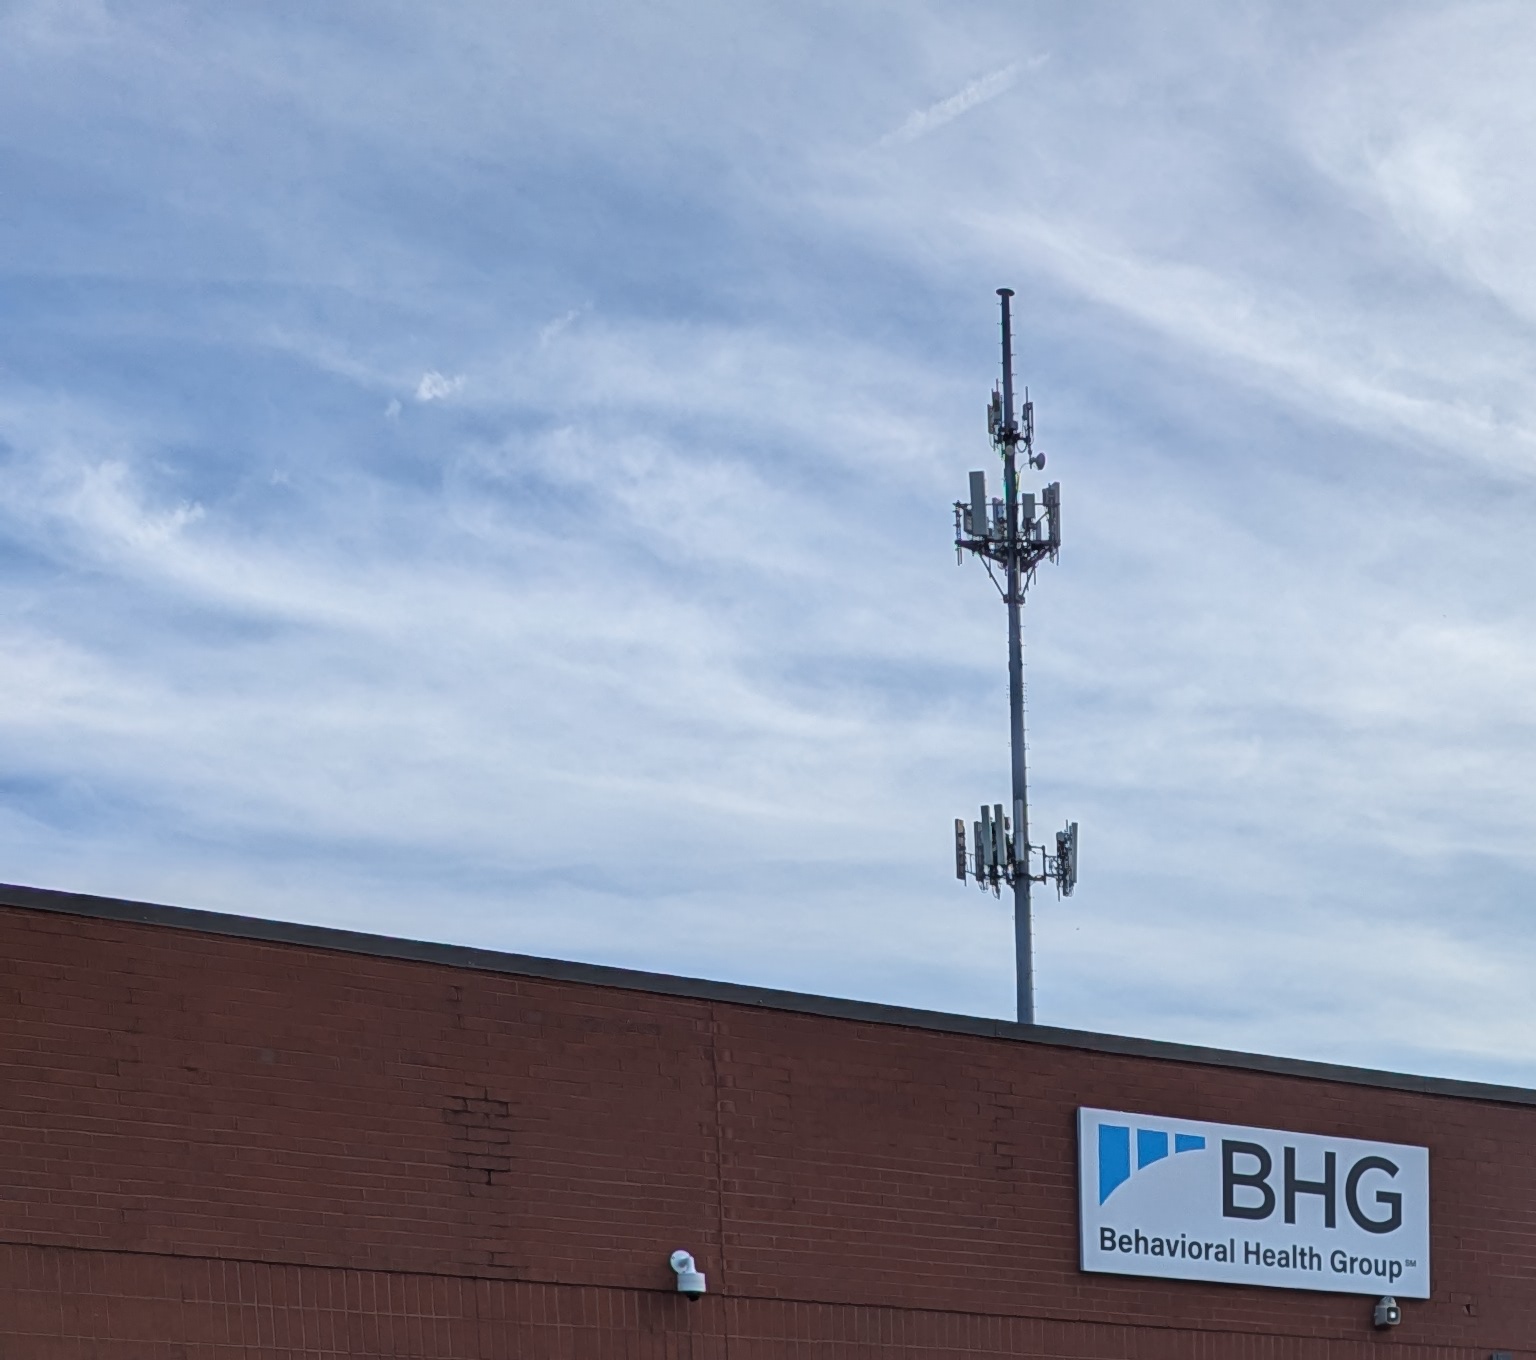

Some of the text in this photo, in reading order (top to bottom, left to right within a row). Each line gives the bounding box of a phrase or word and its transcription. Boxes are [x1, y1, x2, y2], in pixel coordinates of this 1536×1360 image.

[1221, 1138, 1403, 1234] BHG
[1099, 1226, 1236, 1264] Behavioral
[1243, 1240, 1323, 1272] Health
[1330, 1249, 1402, 1283] Group
